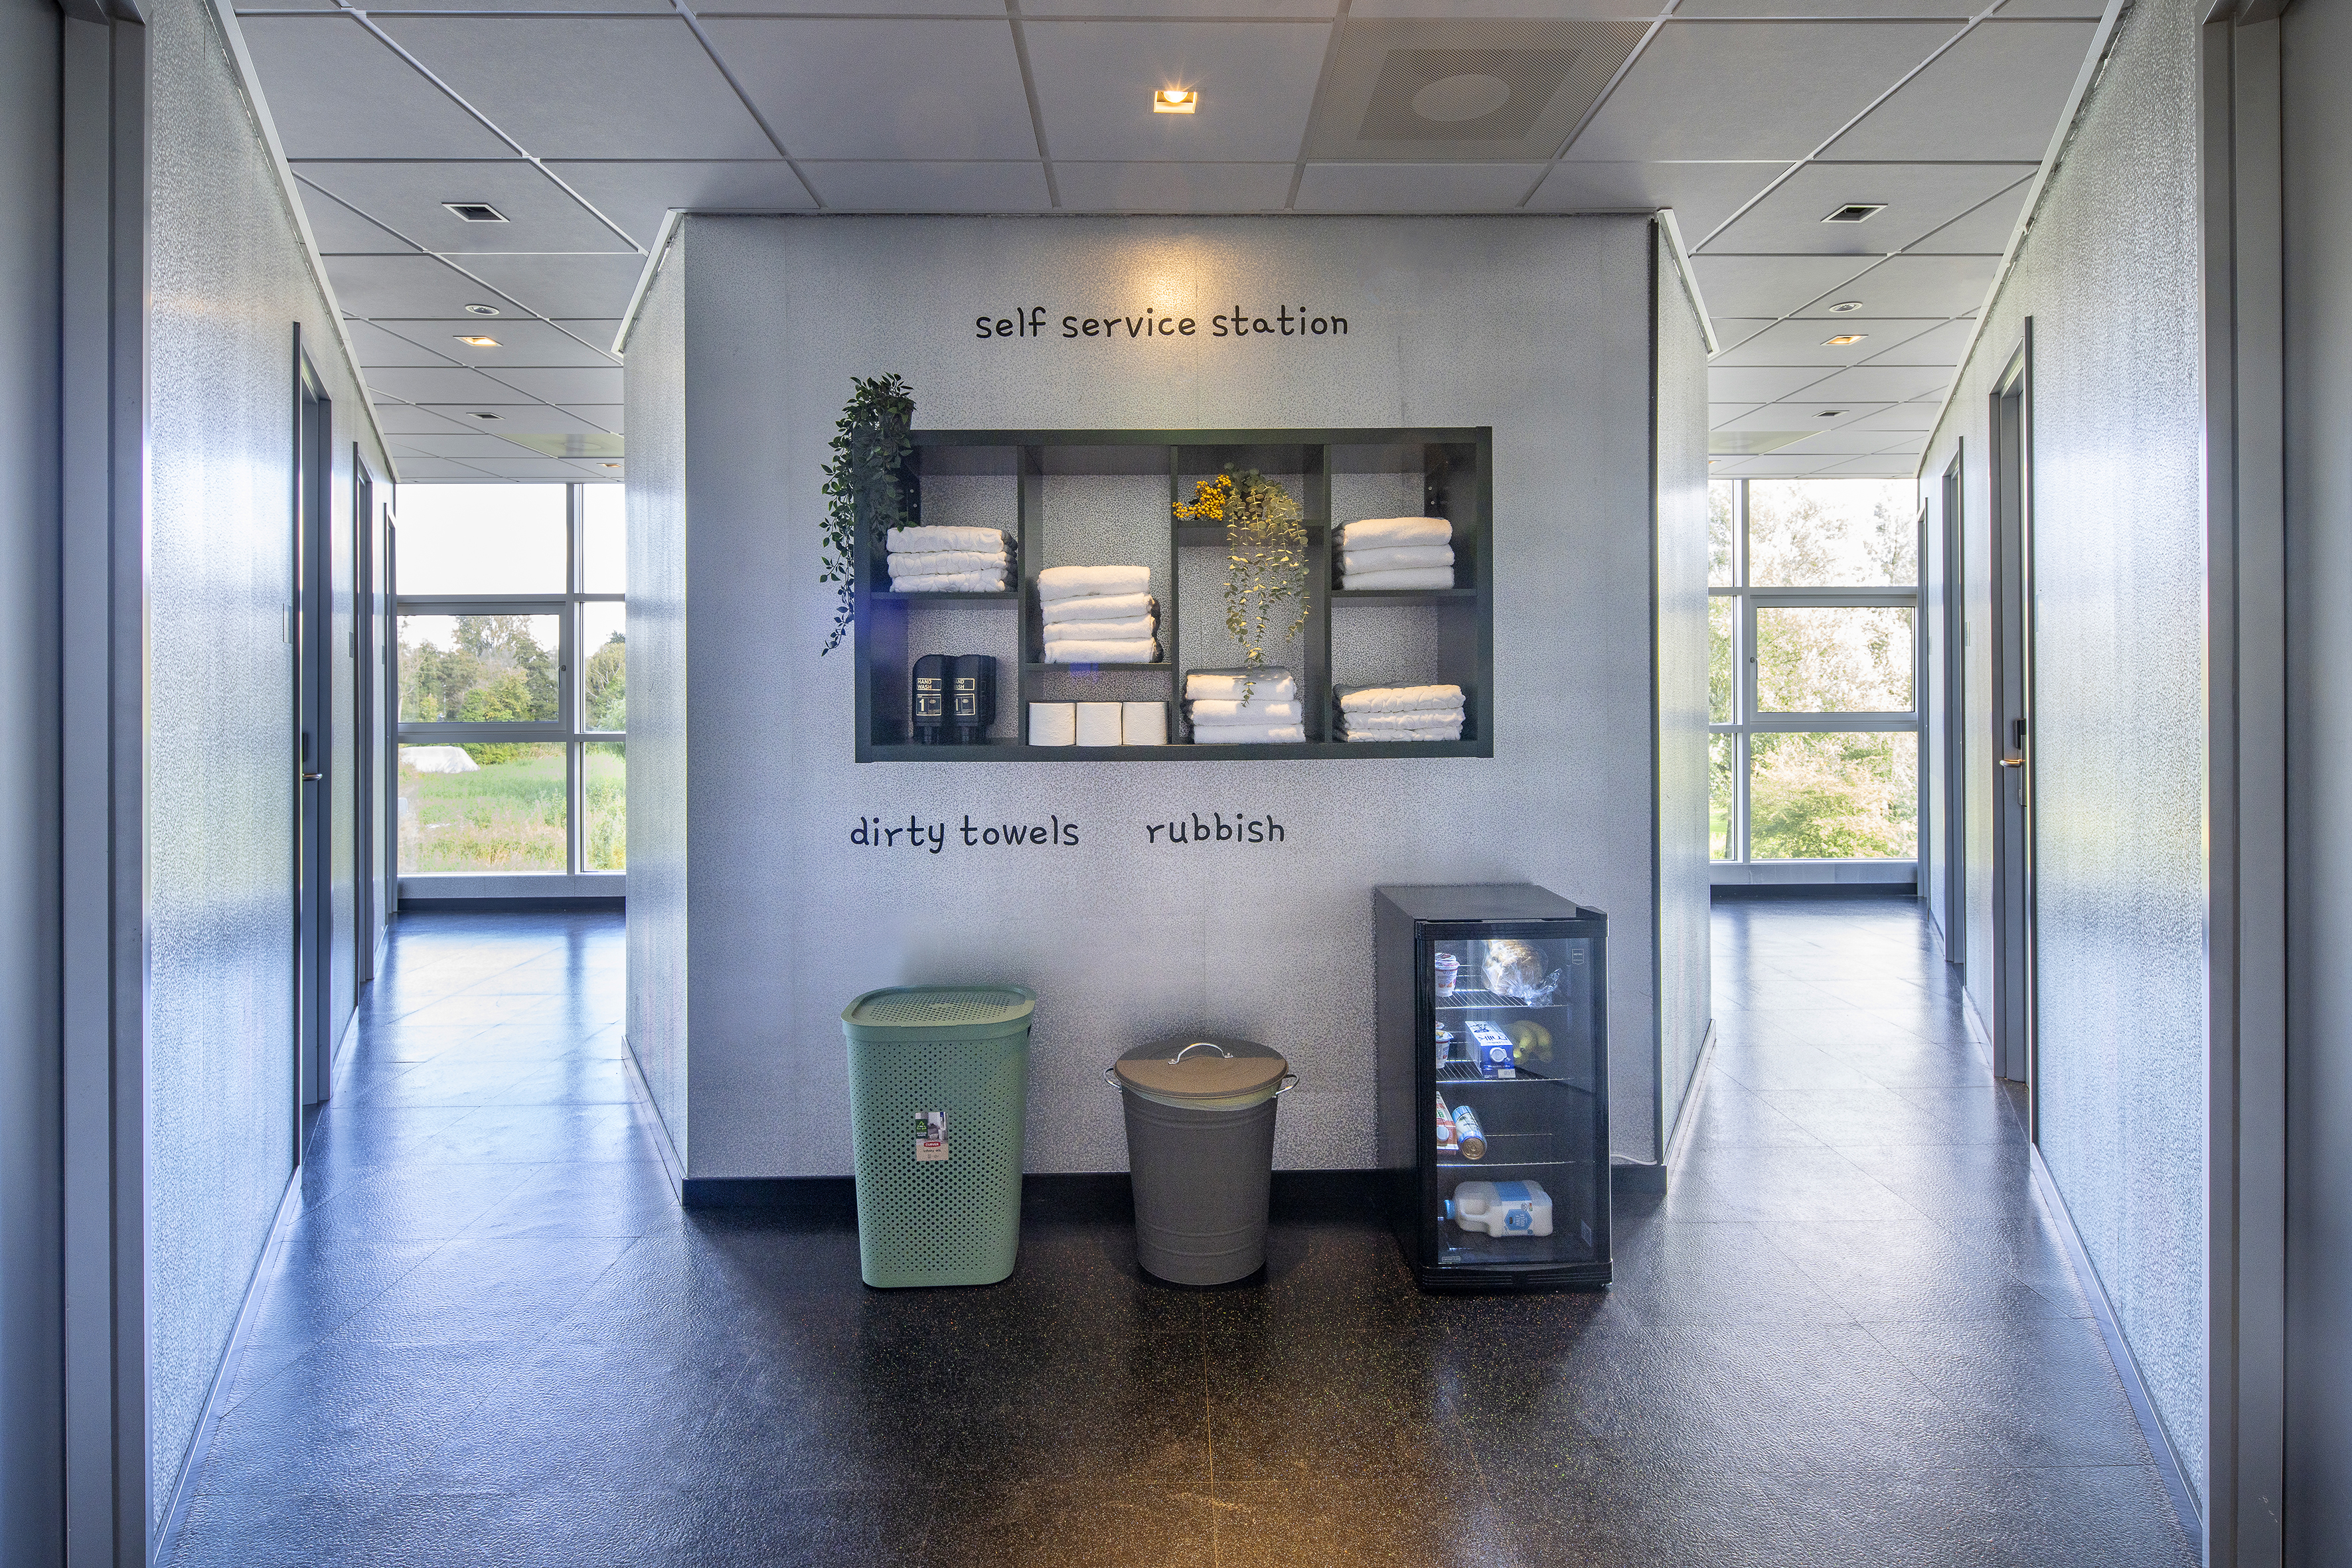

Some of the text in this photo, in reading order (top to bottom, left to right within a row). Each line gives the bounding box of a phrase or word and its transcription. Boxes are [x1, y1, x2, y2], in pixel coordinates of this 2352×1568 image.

[977, 306, 1348, 338] self service station
[919, 698, 925, 712] 1
[851, 816, 1078, 854] dirty towels
[1147, 813, 1285, 842] rubbish
